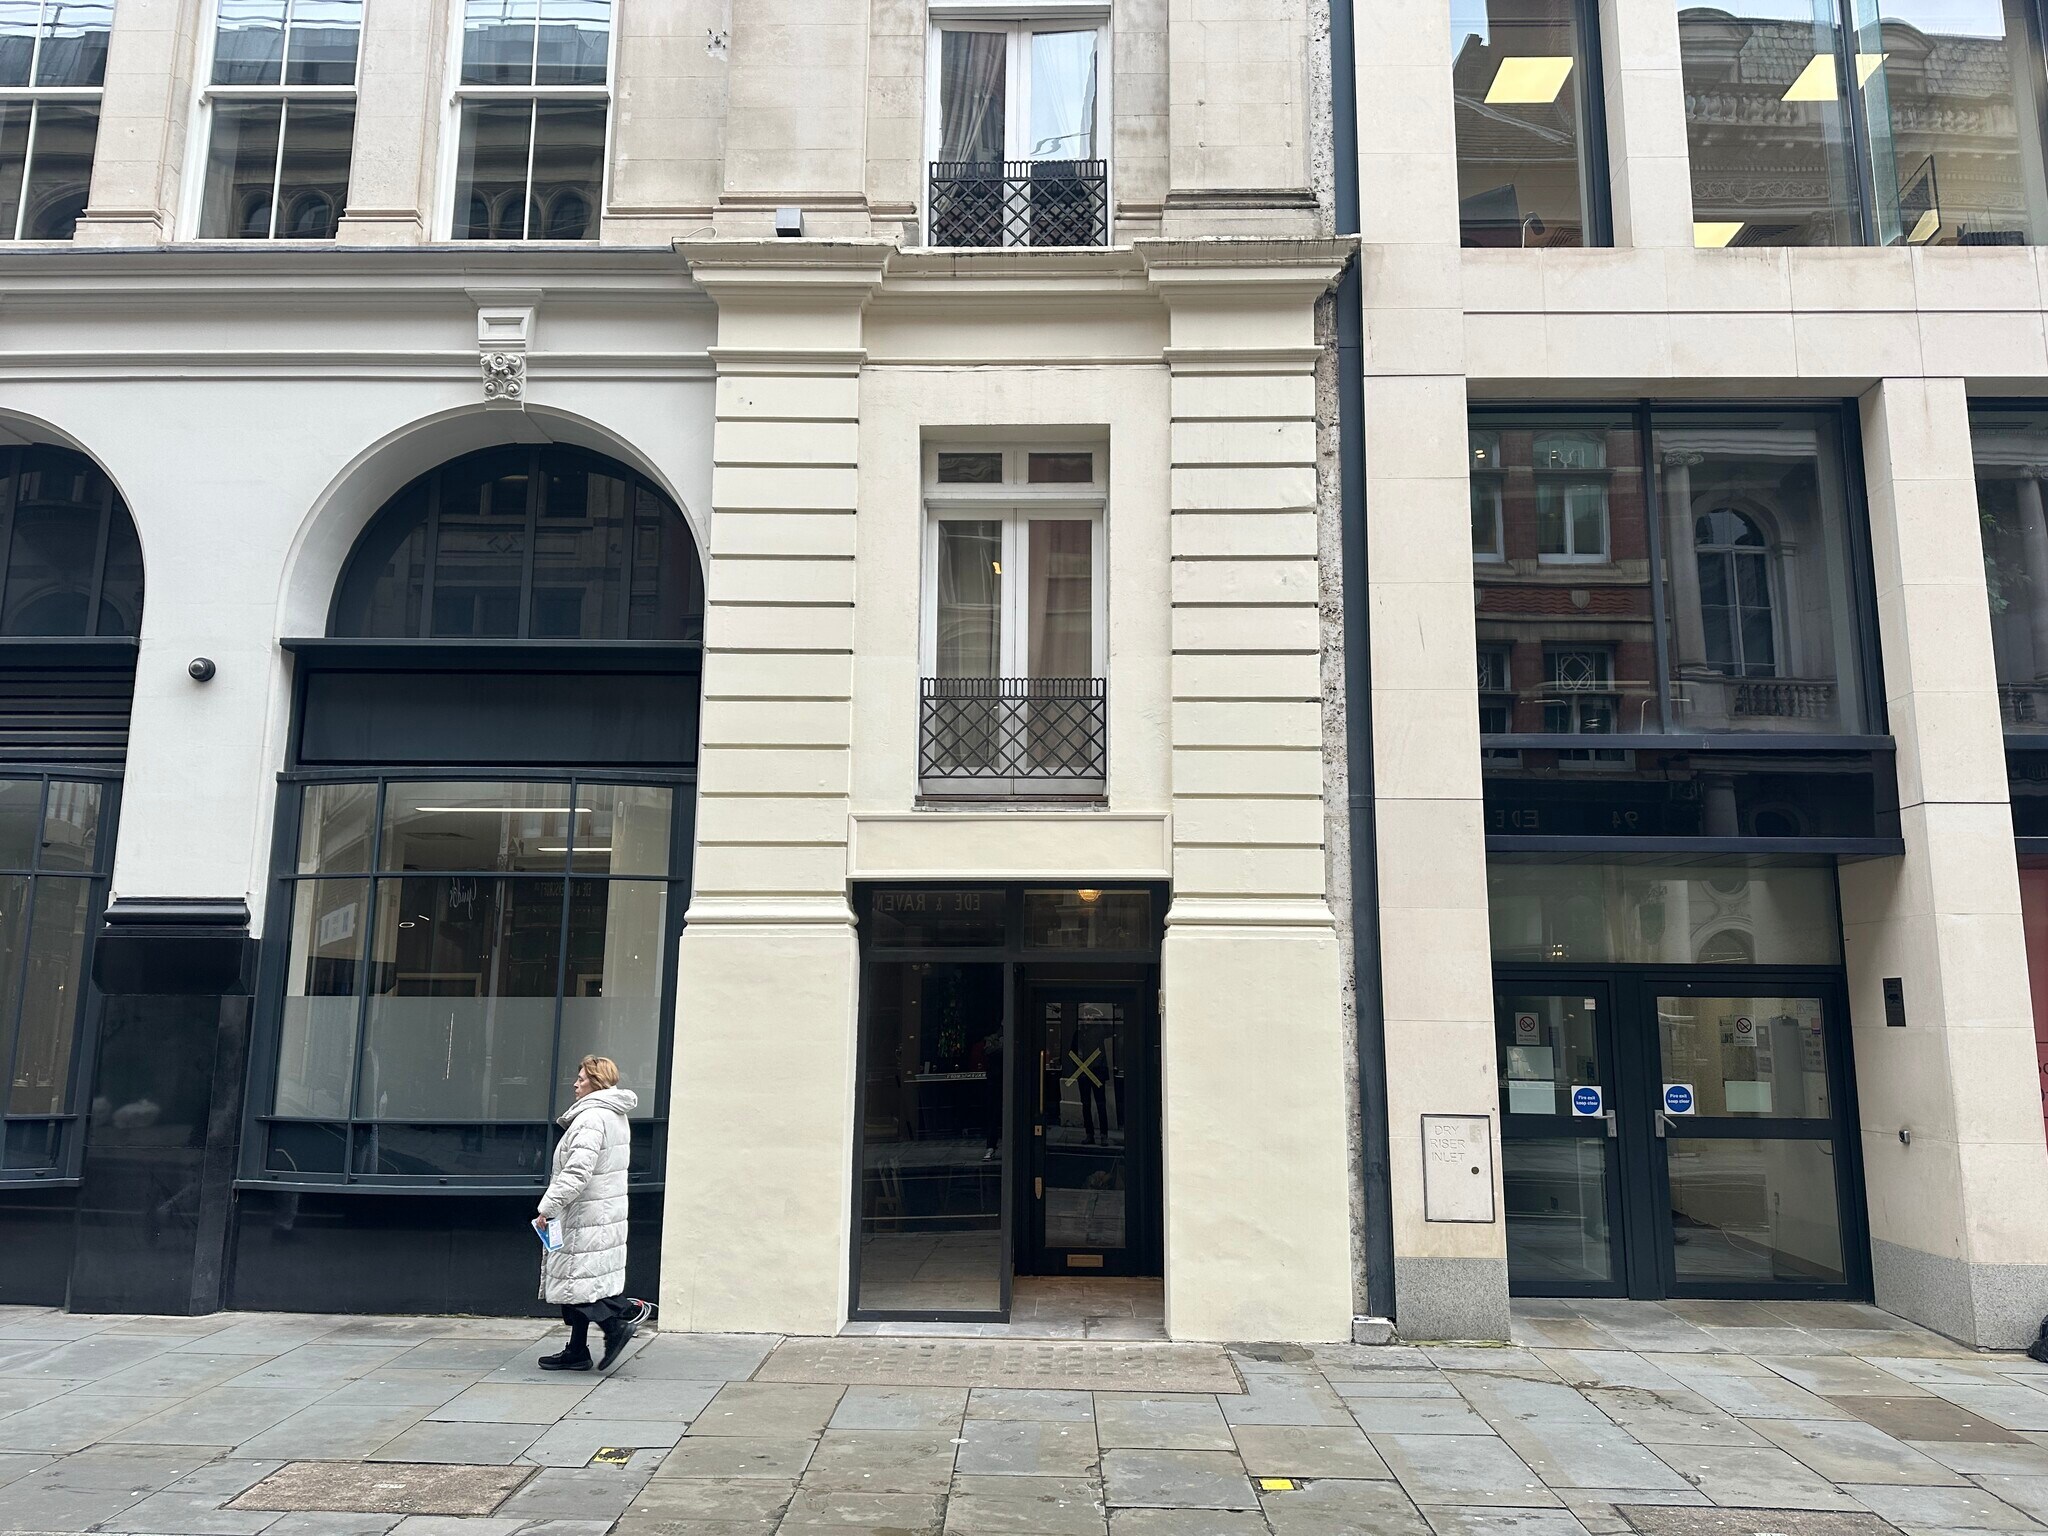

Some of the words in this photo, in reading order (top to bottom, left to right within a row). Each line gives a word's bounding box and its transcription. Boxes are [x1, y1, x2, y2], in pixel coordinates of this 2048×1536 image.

[1434, 1125, 1460, 1136] DRY
[1430, 1138, 1466, 1149] RISER
[1431, 1152, 1465, 1163] INLET
